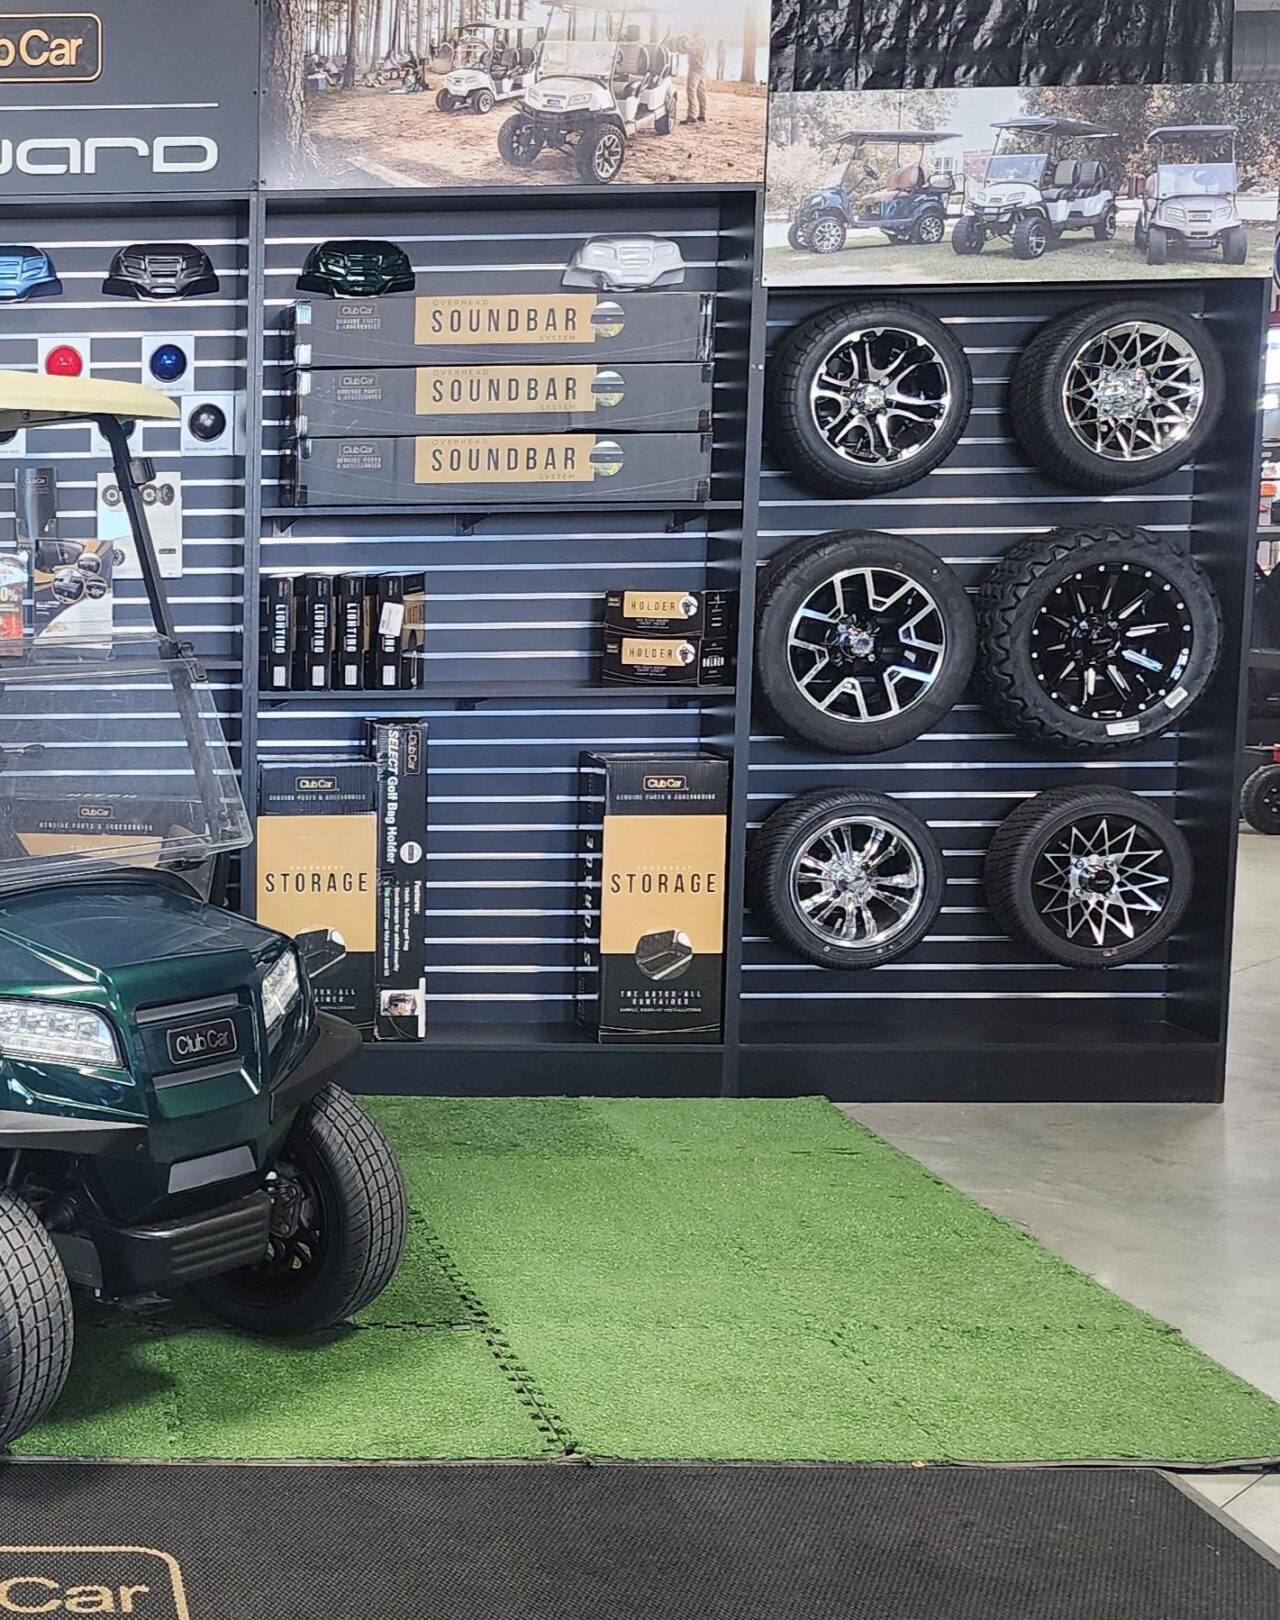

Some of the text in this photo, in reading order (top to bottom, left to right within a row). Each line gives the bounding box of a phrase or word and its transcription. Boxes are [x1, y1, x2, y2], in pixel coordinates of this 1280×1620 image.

[19, 28, 83, 66] Car
[431, 308, 577, 333] SOUNDBAR
[432, 377, 577, 402] SOUNDBAR
[432, 438, 488, 446] OVERHEAD
[431, 447, 576, 472] SOUNDBAR
[631, 601, 676, 611] HOLDER
[629, 648, 673, 659] HOLDER
[407, 735, 417, 770] Club Car
[300, 779, 333, 788] Club Car
[647, 779, 682, 788] Club Car
[385, 730, 399, 864] SELECT Golf Bag Holder
[81, 808, 96, 816] Club
[265, 872, 368, 893] STORAGE
[611, 873, 717, 894] STORAGE
[176, 1029, 229, 1055] Club Car
